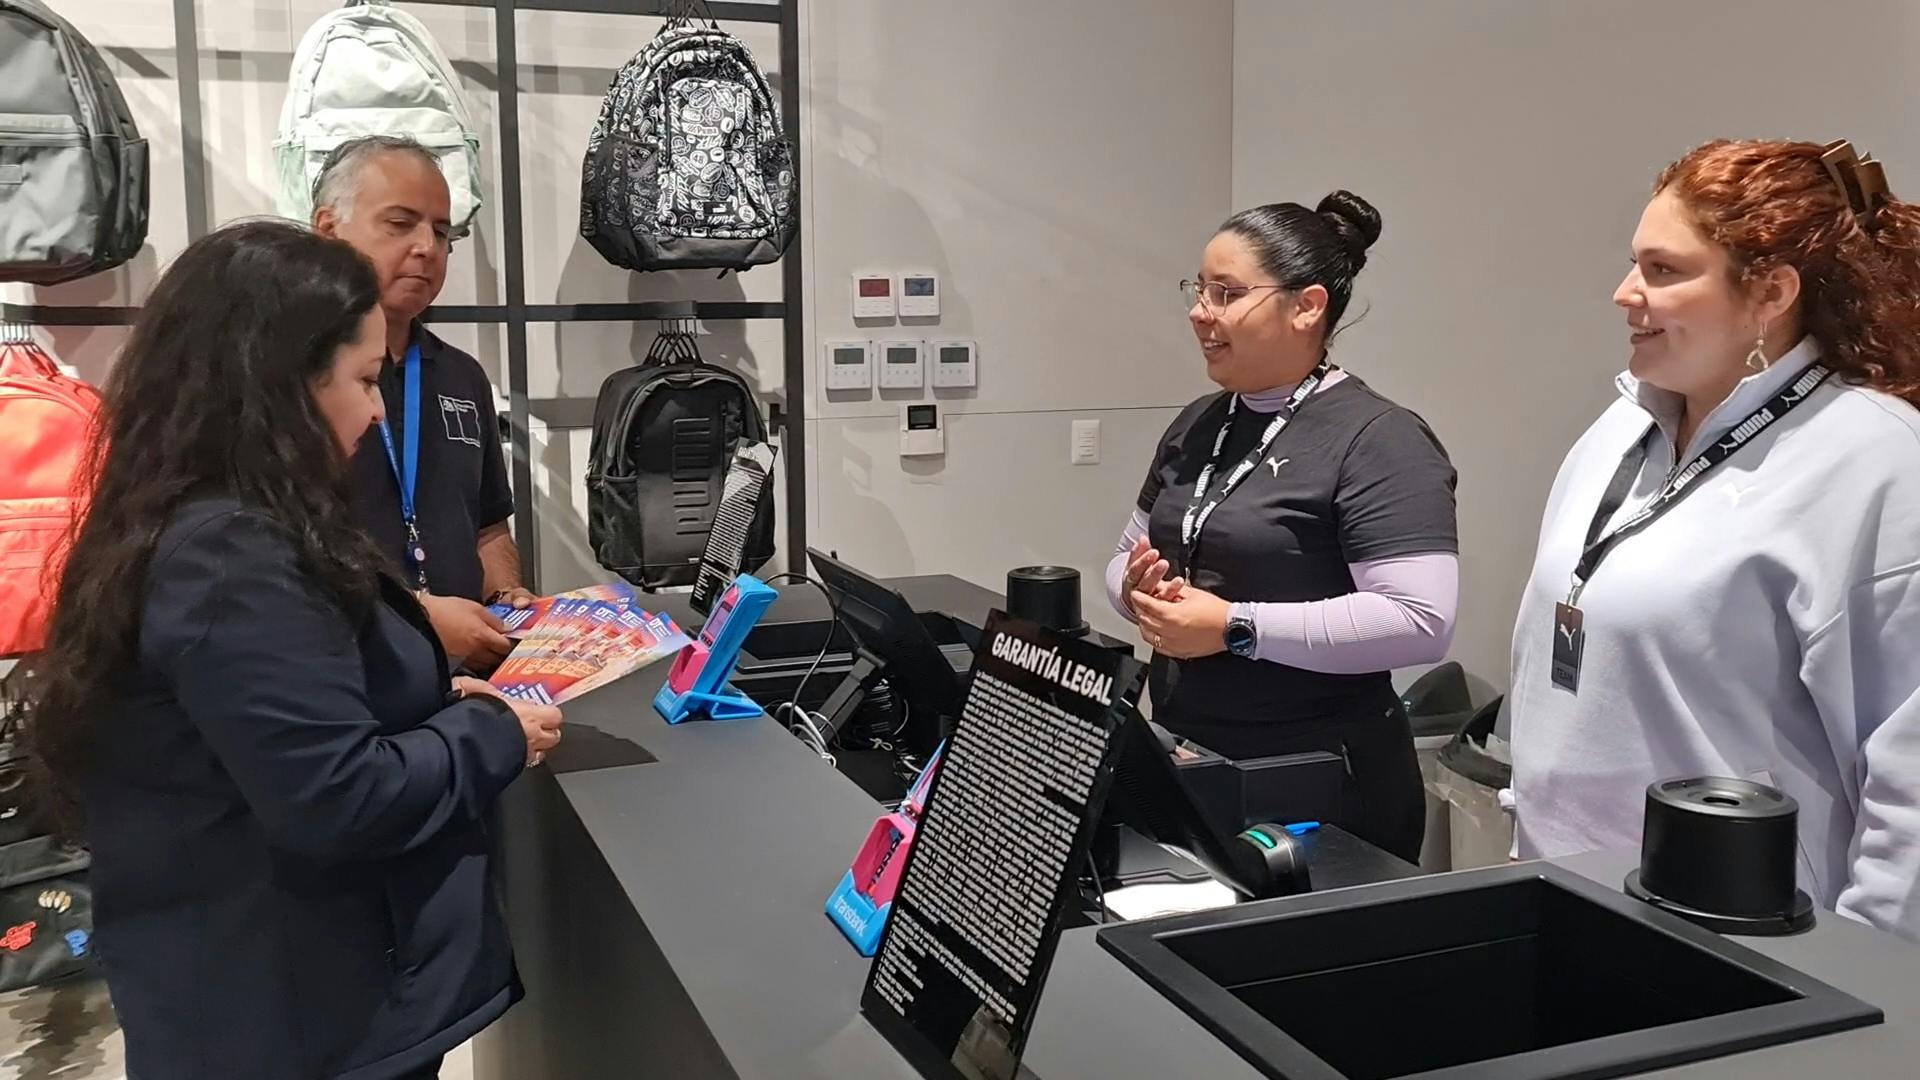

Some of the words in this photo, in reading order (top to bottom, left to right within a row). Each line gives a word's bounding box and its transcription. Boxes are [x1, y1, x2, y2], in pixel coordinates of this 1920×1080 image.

[1730, 408, 1775, 443] PUMA
[1673, 456, 1711, 491] PUMA
[992, 632, 1061, 683] GARANTÍA
[1061, 660, 1113, 706] LEGAL
